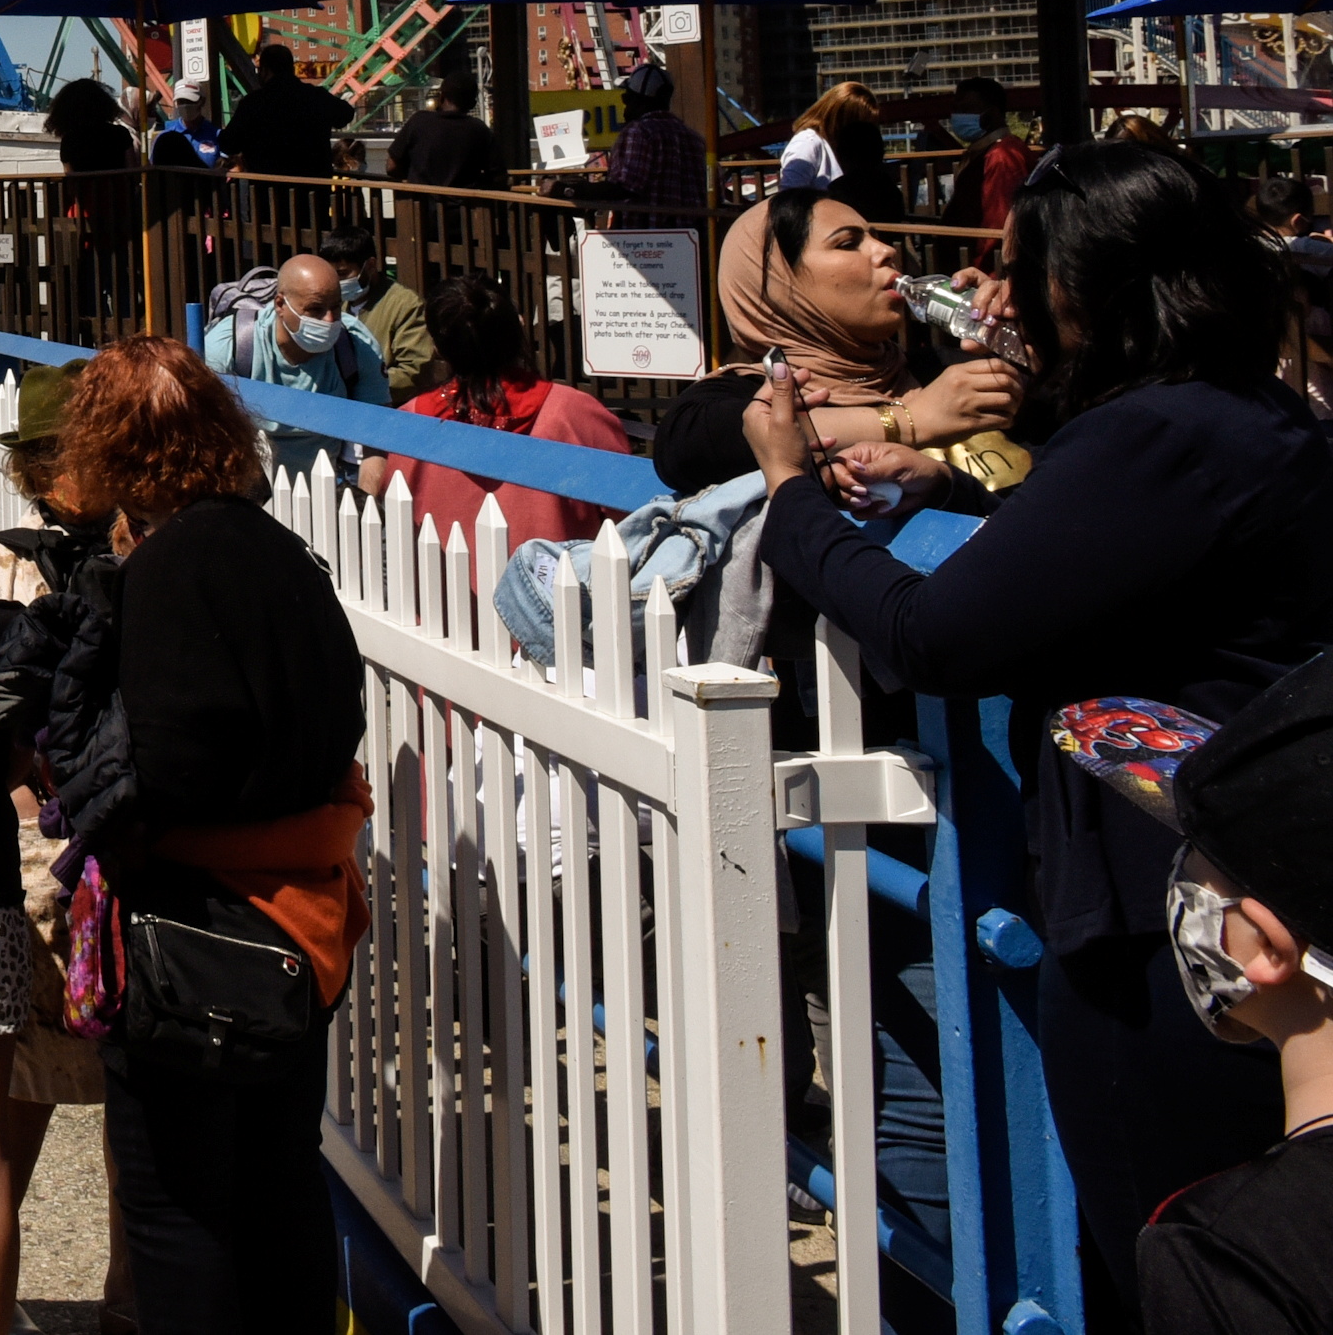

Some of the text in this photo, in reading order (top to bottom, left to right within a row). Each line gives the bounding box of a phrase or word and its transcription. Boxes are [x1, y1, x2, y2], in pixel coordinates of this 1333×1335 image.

[623, 241, 643, 250] forget
[639, 281, 660, 290] taking
[662, 282, 677, 290] your
[595, 291, 617, 299] picture
[669, 292, 685, 300] drop
[622, 310, 646, 319] preview
[657, 311, 687, 319] purchase
[654, 321, 667, 330] Say
[594, 331, 612, 339] photo
